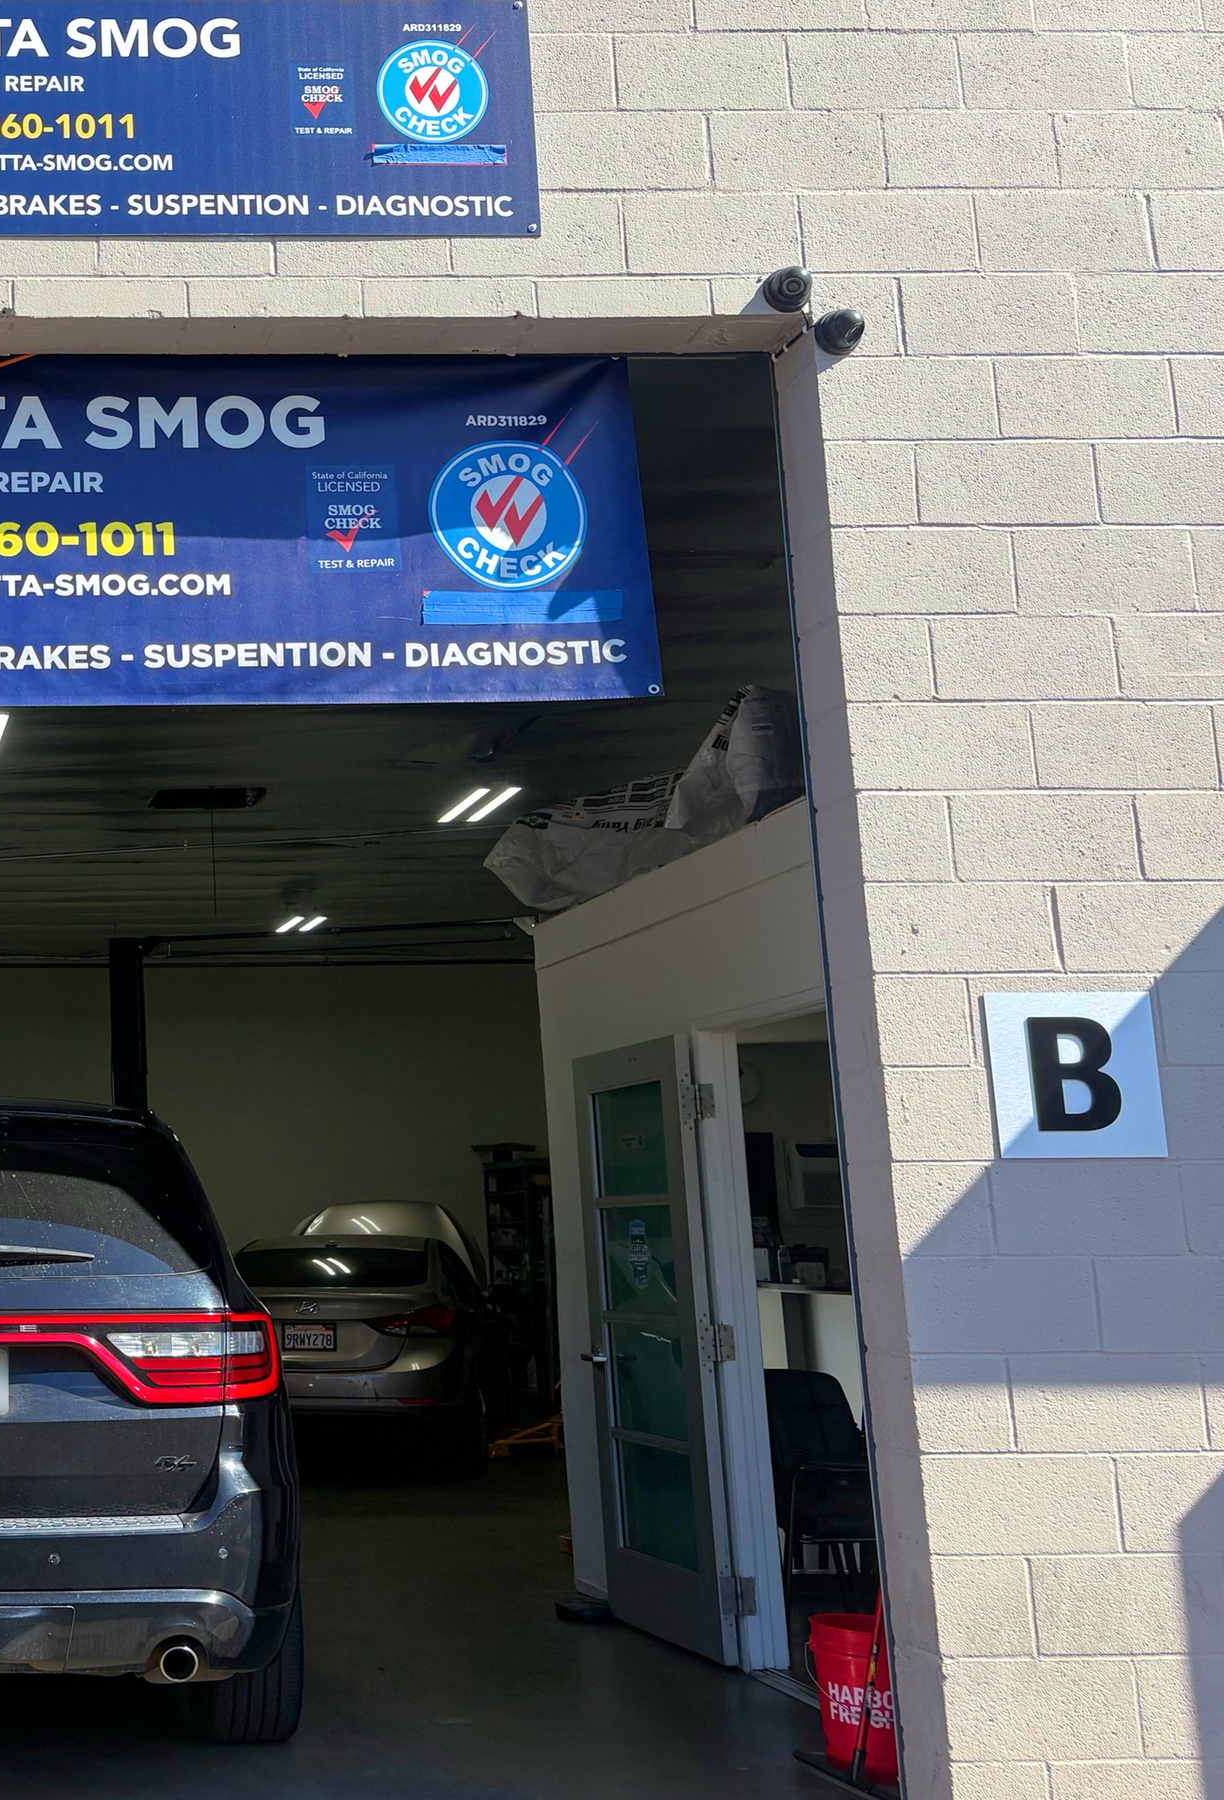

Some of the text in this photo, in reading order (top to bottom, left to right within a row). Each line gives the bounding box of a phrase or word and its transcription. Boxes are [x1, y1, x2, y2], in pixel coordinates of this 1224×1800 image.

[402, 23, 462, 32] ARD311829
[66, 17, 241, 59] SMOG
[397, 48, 466, 74] SMOG
[4, 75, 85, 92] REPAIR
[304, 85, 339, 94] SMOG
[301, 93, 343, 103] CHECK
[394, 105, 475, 136] CHECK
[294, 127, 353, 135] TEST & REPAIR
[127, 194, 310, 216] SUSPENTION
[336, 194, 514, 217] DIAGNOSTIC
[84, 394, 326, 450] SMOG
[465, 414, 547, 428] ARD311829
[311, 471, 388, 480] State of California
[458, 453, 554, 488] SMOG
[317, 482, 380, 493] LICENSED
[327, 504, 376, 516] SMOG
[324, 517, 382, 529] CHECK
[317, 558, 395, 569] TEST & REPAIR
[457, 536, 567, 579] CHECK
[143, 641, 372, 669] SUSPENTION
[405, 638, 627, 668] DIAGNOSTIC
[1025, 1016, 1123, 1132] B
[286, 1333, 333, 1347] 9RWY278
[828, 1681, 893, 1708] HARBO
